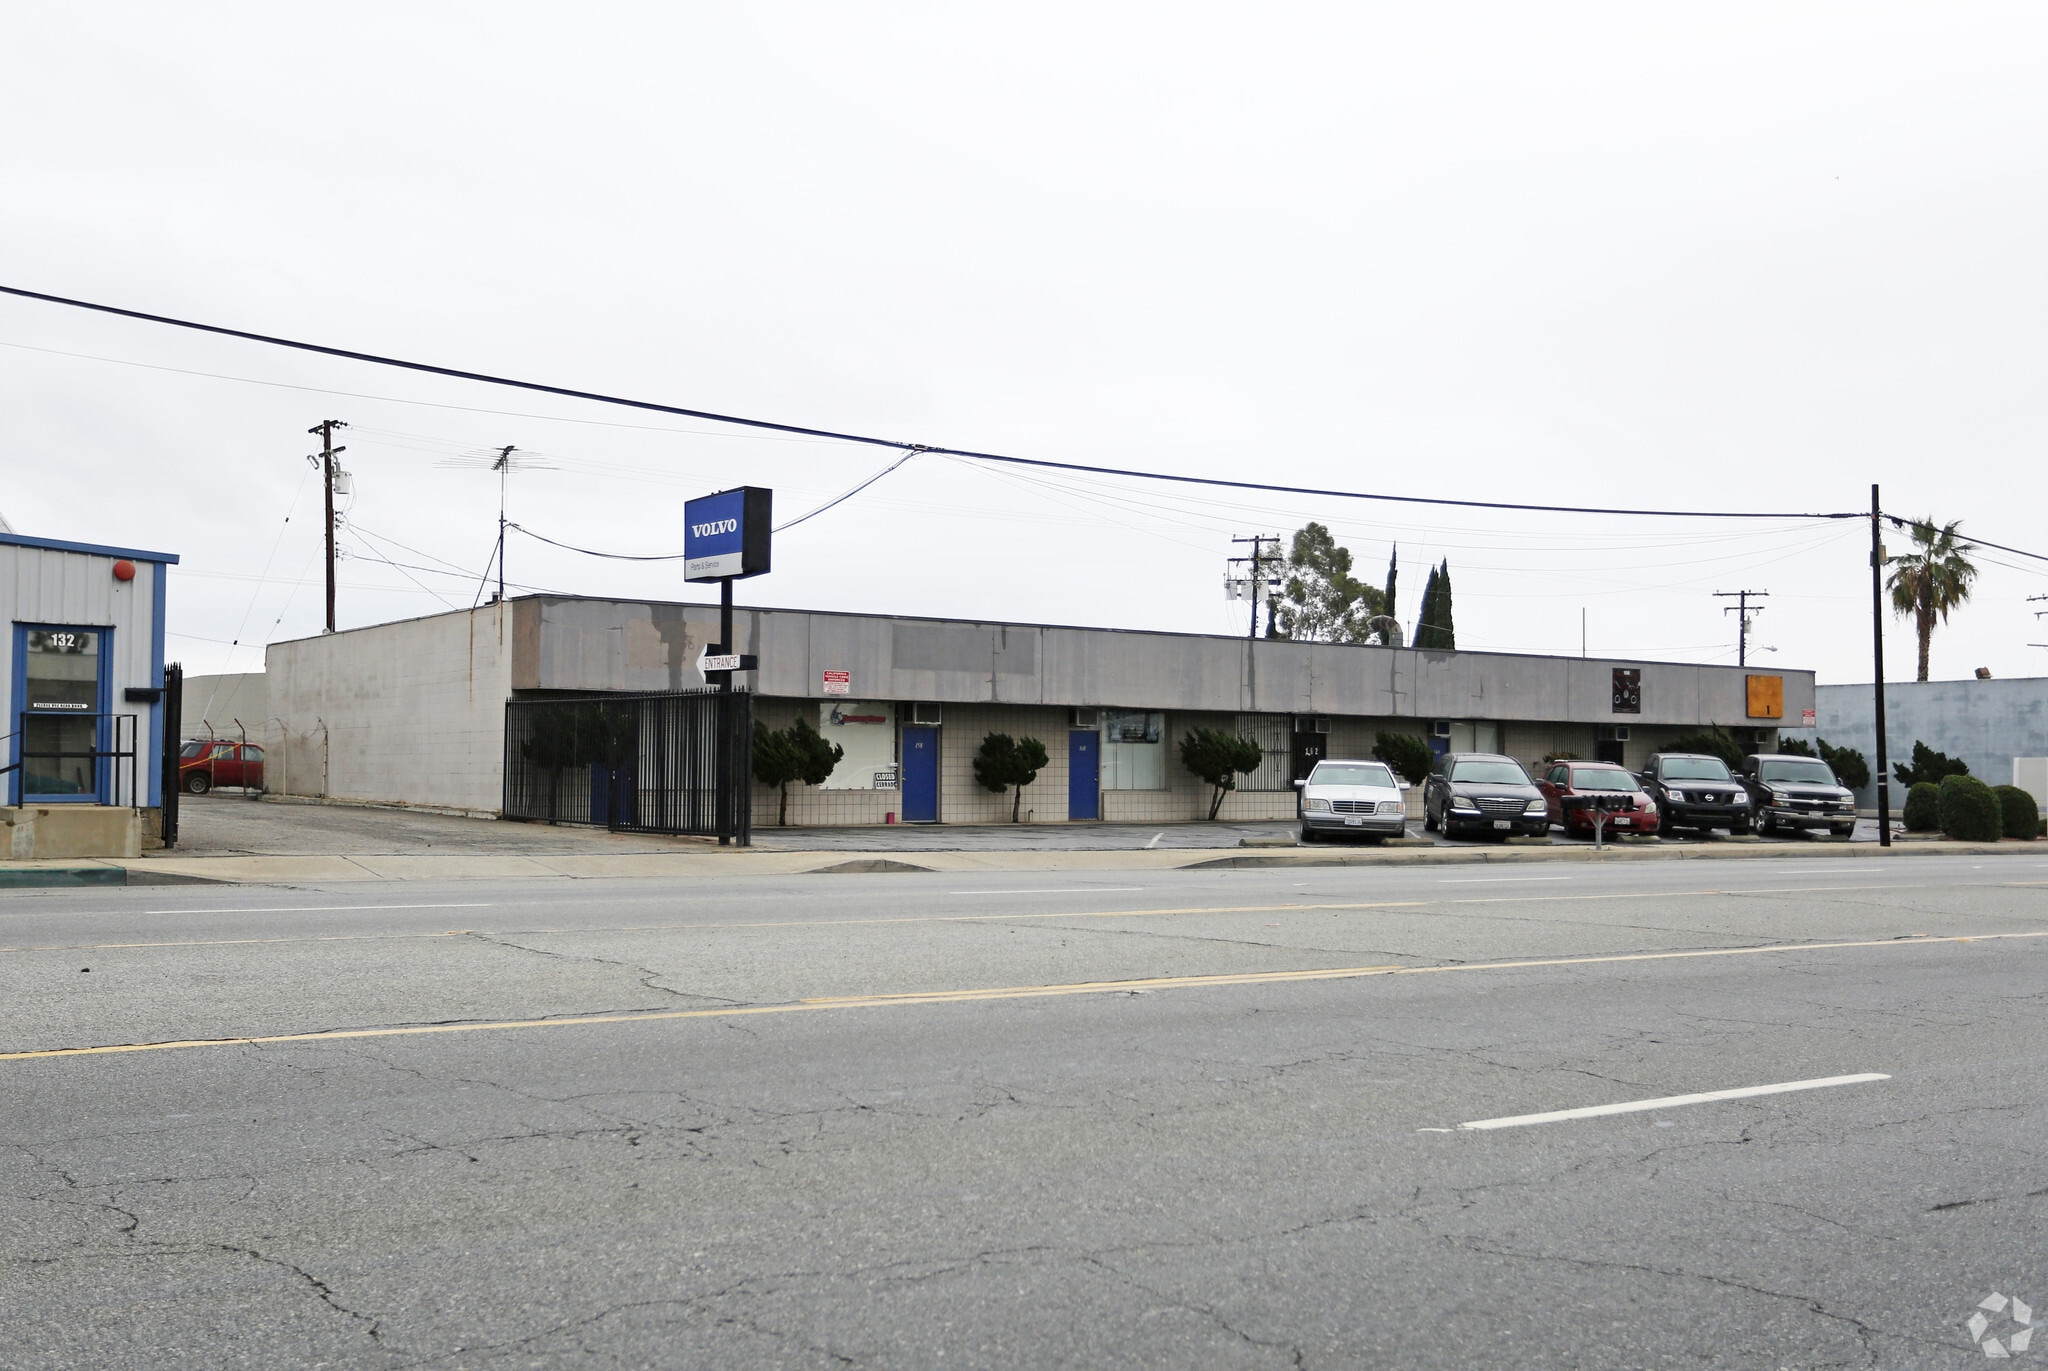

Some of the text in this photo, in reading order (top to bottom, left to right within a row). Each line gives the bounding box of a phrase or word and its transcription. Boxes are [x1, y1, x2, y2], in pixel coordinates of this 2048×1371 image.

[692, 518, 737, 538] VOLVO
[705, 561, 720, 570] Service
[51, 633, 75, 647] 132
[705, 656, 737, 669] ENTRANCE
